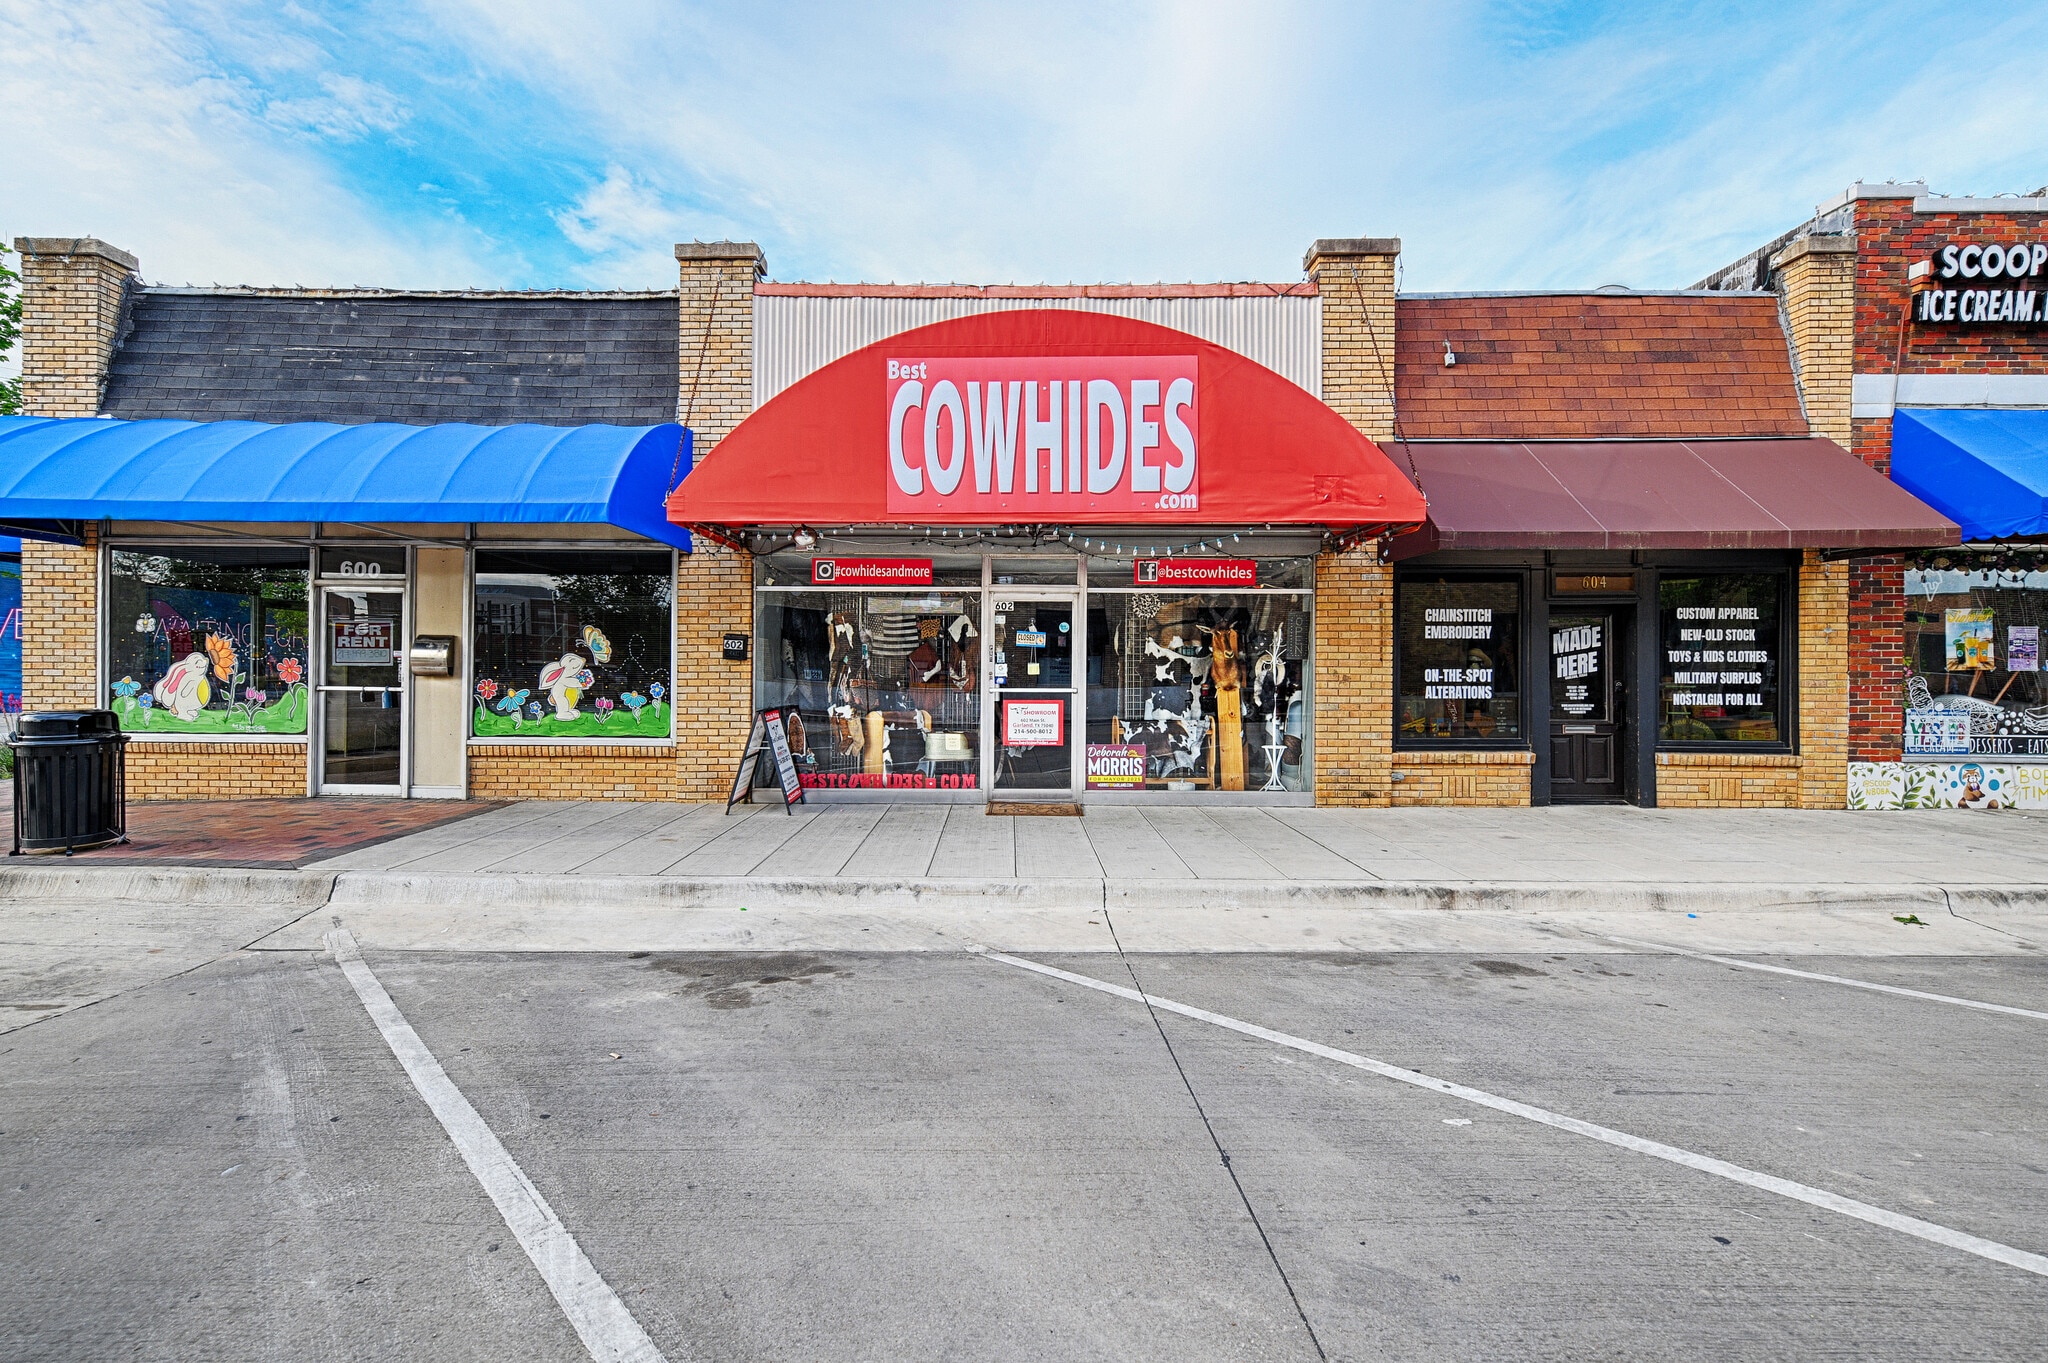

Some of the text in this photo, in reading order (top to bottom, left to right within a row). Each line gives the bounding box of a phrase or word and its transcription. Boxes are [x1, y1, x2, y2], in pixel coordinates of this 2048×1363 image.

[1941, 244, 2048, 278] SCOOP
[1921, 290, 1957, 321] ICE
[888, 360, 927, 380] Best
[889, 378, 1196, 494] COWHIDES
[1154, 493, 1197, 510] .com
[340, 561, 381, 578] 600
[835, 564, 930, 578] #cowhidesandmore
[1158, 566, 1252, 579] @bestcowhides
[1582, 576, 1606, 588] 604
[995, 602, 1013, 610] 602
[1425, 609, 1492, 622] CHAINSTITCH
[1676, 608, 1759, 620] CUSTOM APPAREL
[343, 624, 382, 636] FOR
[1425, 626, 1492, 639] EMBROIDERY
[1681, 629, 1755, 641] NEW-OLD STOCK
[337, 637, 388, 647] RENT
[725, 640, 743, 649] 602
[1553, 626, 1601, 654] MADE
[1668, 651, 1767, 662] TOYS & KIDS CLOTHES
[1557, 651, 1598, 678] HERE
[1425, 669, 1493, 682] ON-THE-SPOT
[1674, 672, 1761, 684] MILITARY SURPLUS
[1425, 686, 1493, 699] ALTERATIONS
[1673, 694, 1763, 706] NOSTALGIA FOR ALL
[1088, 746, 1128, 757] Deborah
[1969, 738, 2014, 754] DESSERTS
[1088, 757, 1143, 776] MORRIS
